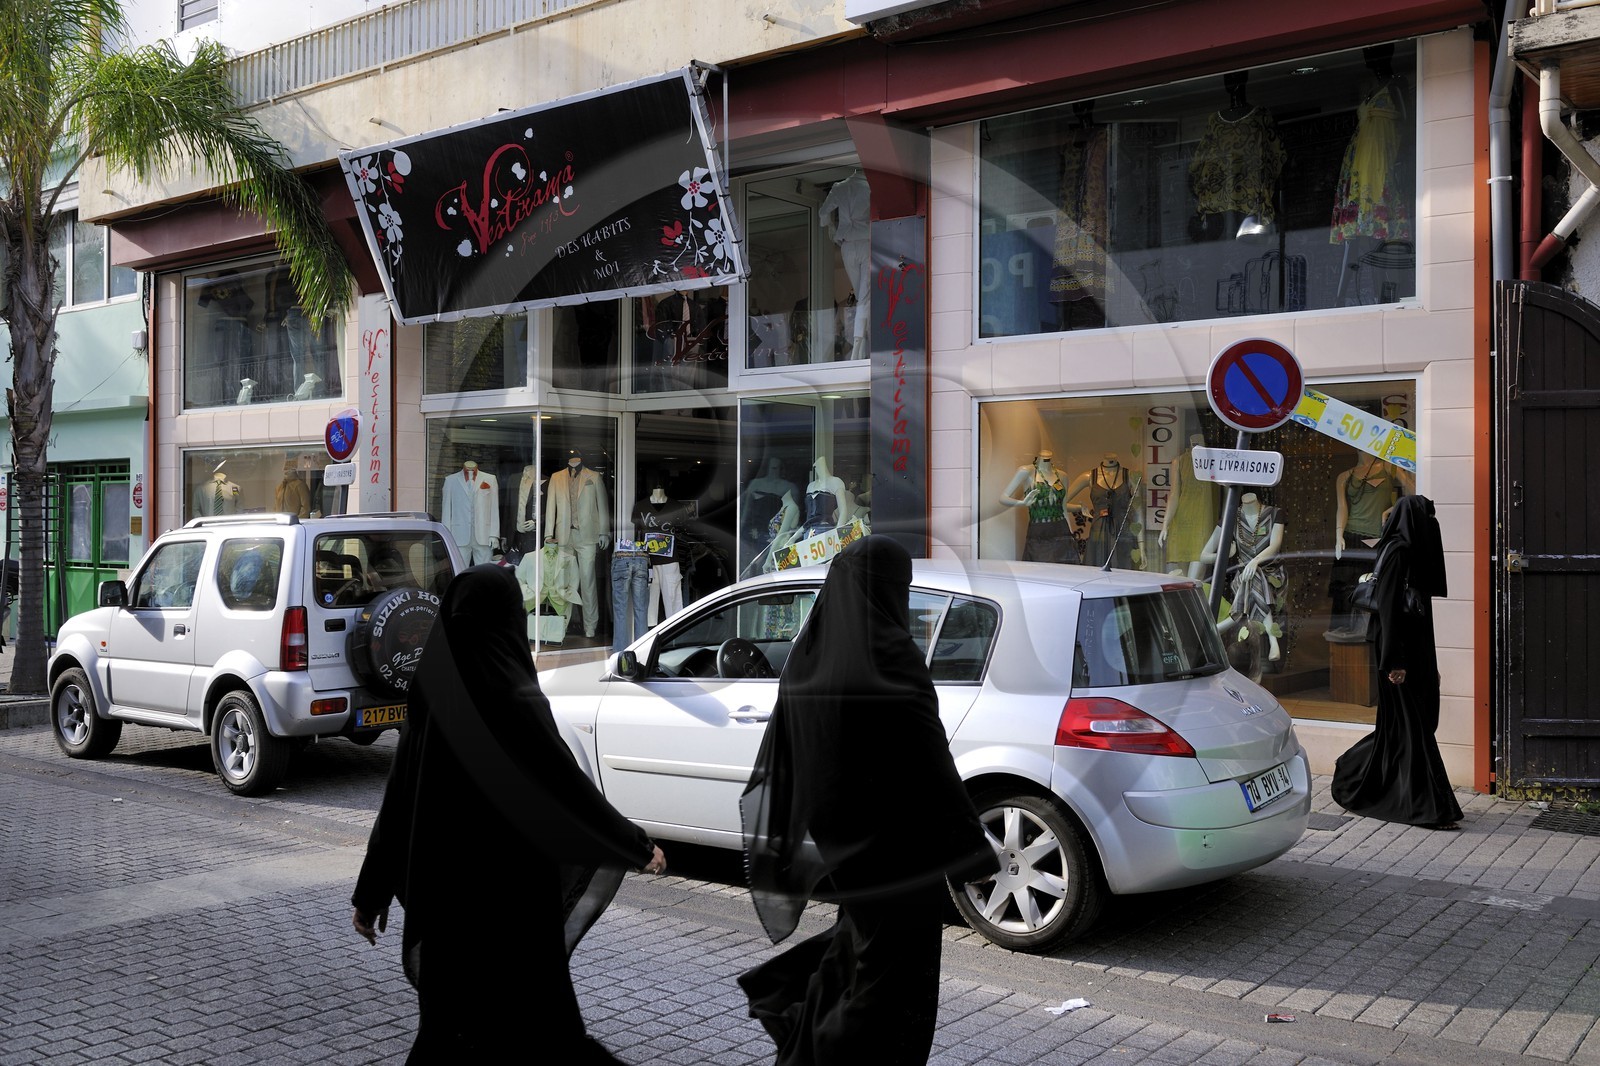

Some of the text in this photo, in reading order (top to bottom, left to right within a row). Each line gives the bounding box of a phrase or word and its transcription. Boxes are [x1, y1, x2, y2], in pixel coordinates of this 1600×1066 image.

[581, 217, 631, 248] HABITS
[595, 249, 607, 261] &
[593, 261, 620, 280] MOI
[878, 256, 925, 473] Vestirama
[362, 328, 389, 484] Vestirama
[1194, 458, 1276, 474] SAUF LIVRAISONS
[373, 591, 411, 638] SUZUKI
[364, 709, 386, 724] 217
